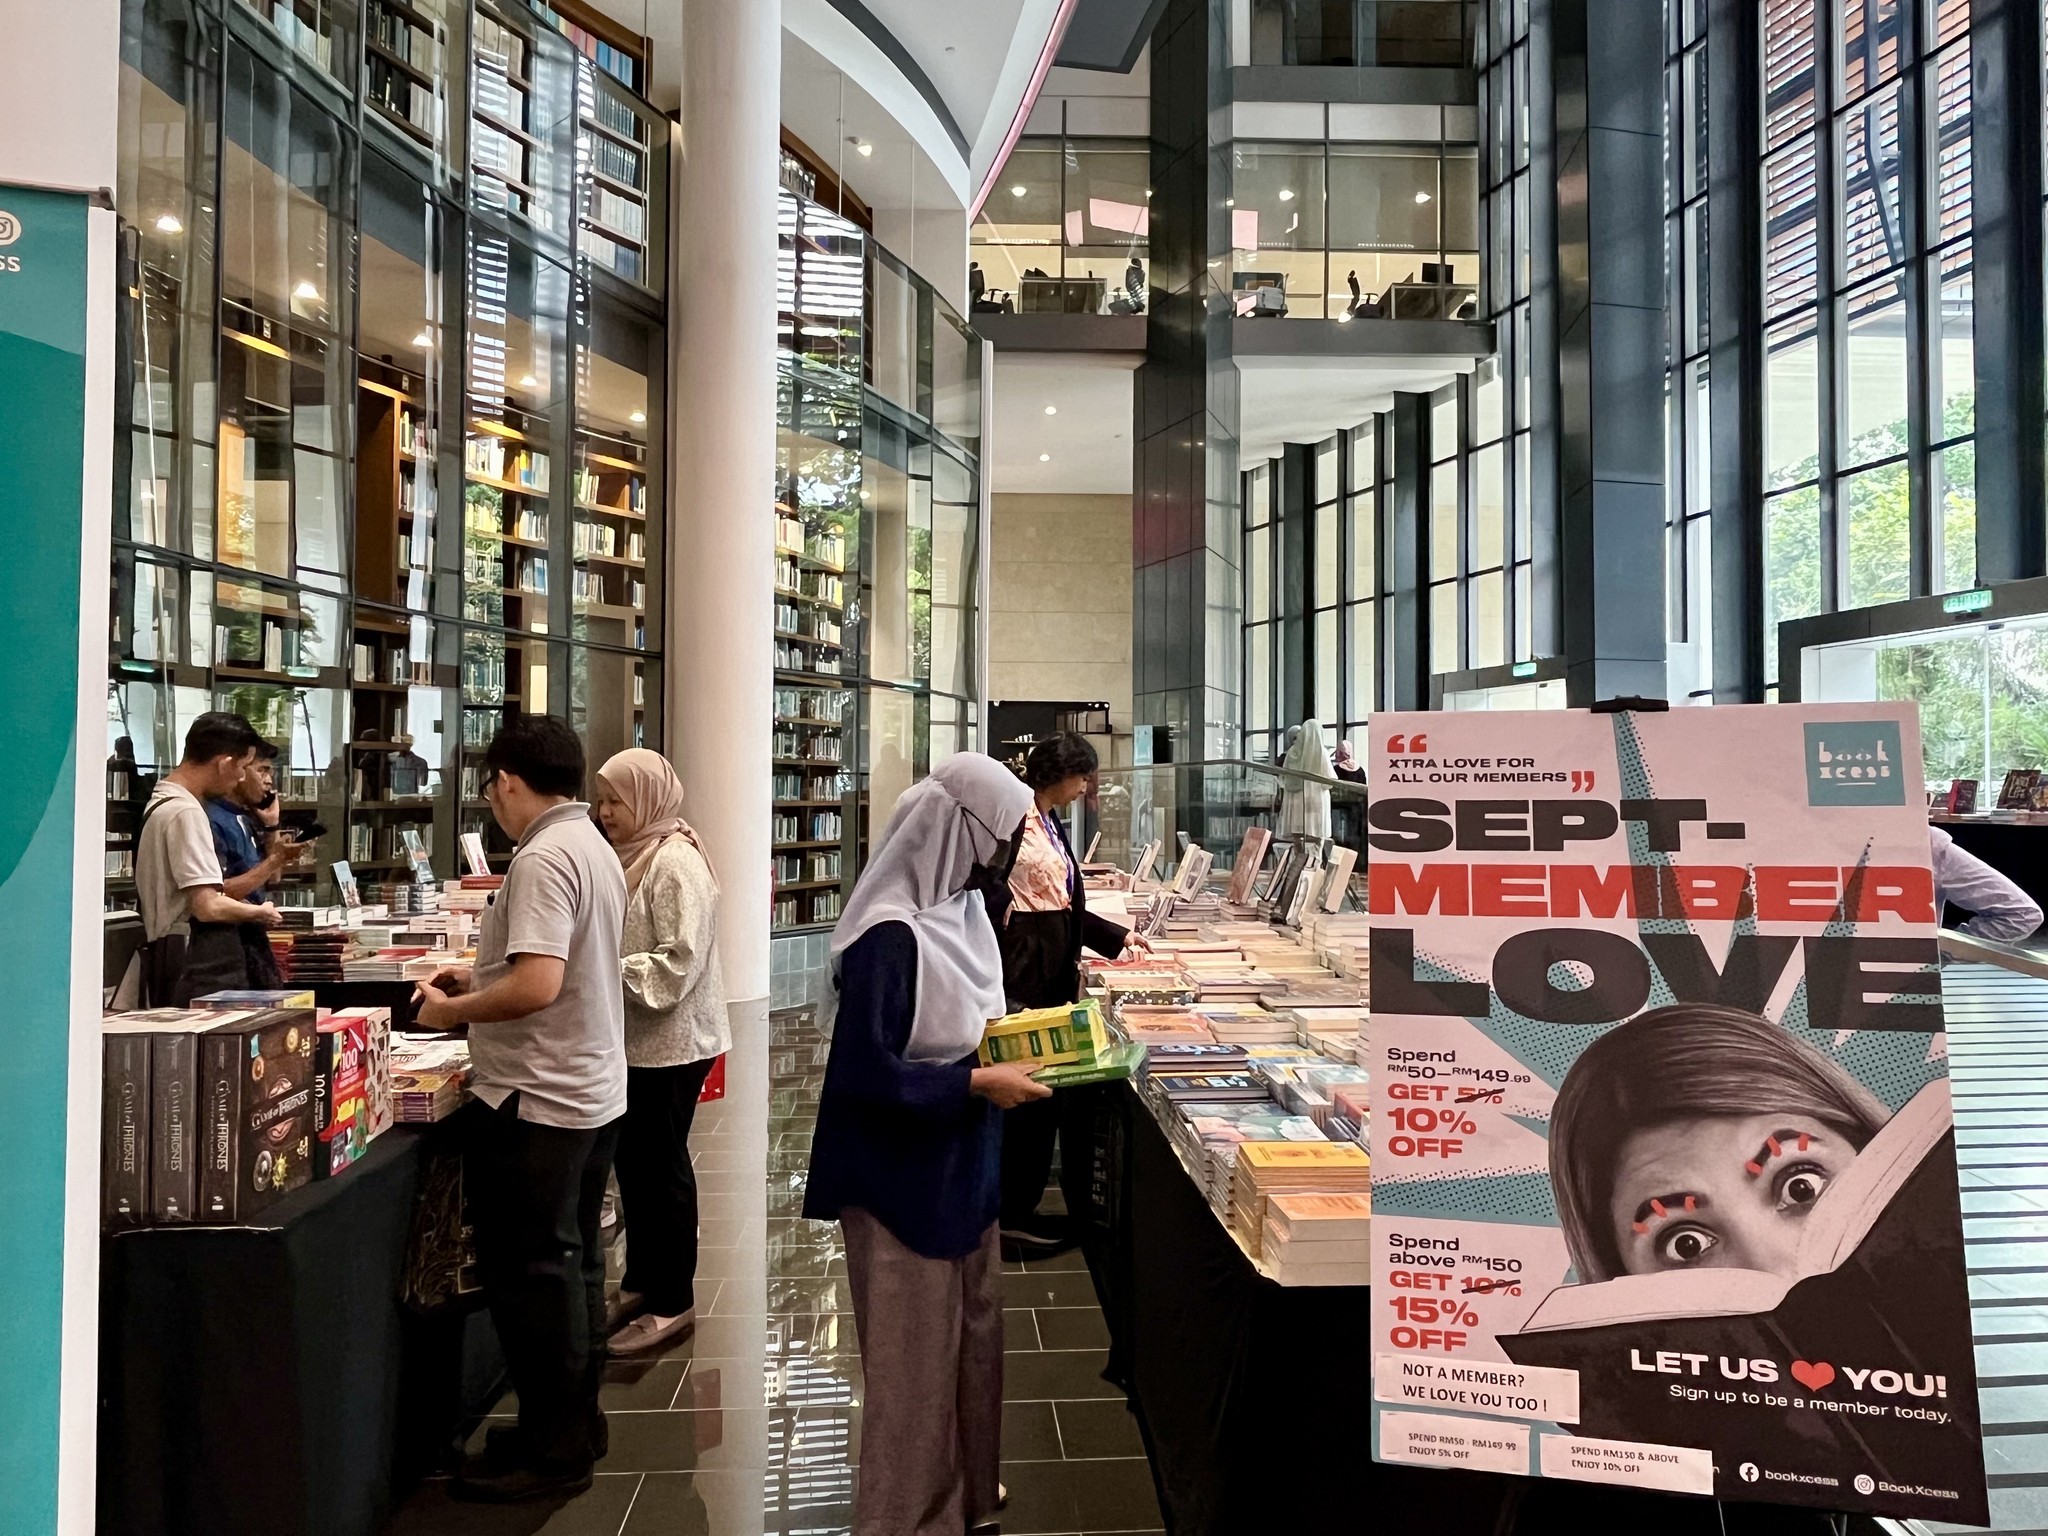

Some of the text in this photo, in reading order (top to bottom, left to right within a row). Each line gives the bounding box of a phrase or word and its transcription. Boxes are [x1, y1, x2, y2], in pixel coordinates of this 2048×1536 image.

[1389, 758, 1535, 768] XTRA LOVE FOR
[1819, 740, 1889, 763] book
[1389, 773, 1424, 783] ALL
[1429, 773, 1468, 783] OUR
[1368, 798, 1745, 853] SEPT-
[1368, 862, 1935, 923] MEMBER
[1369, 927, 1943, 1032] LOVE
[341, 1048, 358, 1072] 100
[1387, 1047, 1456, 1063] Spend
[1387, 1083, 1449, 1101] GET
[1387, 1107, 1477, 1135] 10%
[216, 1120, 229, 1173] THRONES
[1388, 1136, 1463, 1159] OFF
[1389, 1233, 1460, 1251] Spend
[1389, 1251, 1522, 1273] above RM150
[1389, 1270, 1452, 1291] GET
[1389, 1295, 1479, 1327] 15%
[1390, 1326, 1467, 1351] OFF
[1402, 1362, 1525, 1387] NOT A MEMBER?
[1630, 1349, 1948, 1398] LET US YOU!
[1402, 1384, 1426, 1398] WE
[1430, 1388, 1466, 1403] LOVE
[1471, 1391, 1502, 1407] YOU
[1506, 1396, 1538, 1411] TOO
[1669, 1384, 1952, 1425] Sign up to be a member today.
[1408, 1432, 1437, 1443] SPEND
[1439, 1435, 1465, 1446] RM50
[1409, 1446, 1470, 1459] ENJOY 5% OFF
[1571, 1446, 1679, 1464] SPEND RM150 & ABOVE
[1572, 1459, 1600, 1470] ENJOY
[1603, 1462, 1622, 1472] 10%
[1764, 1469, 1839, 1487] bookxcess
[1878, 1481, 1959, 1500] BookXcess
